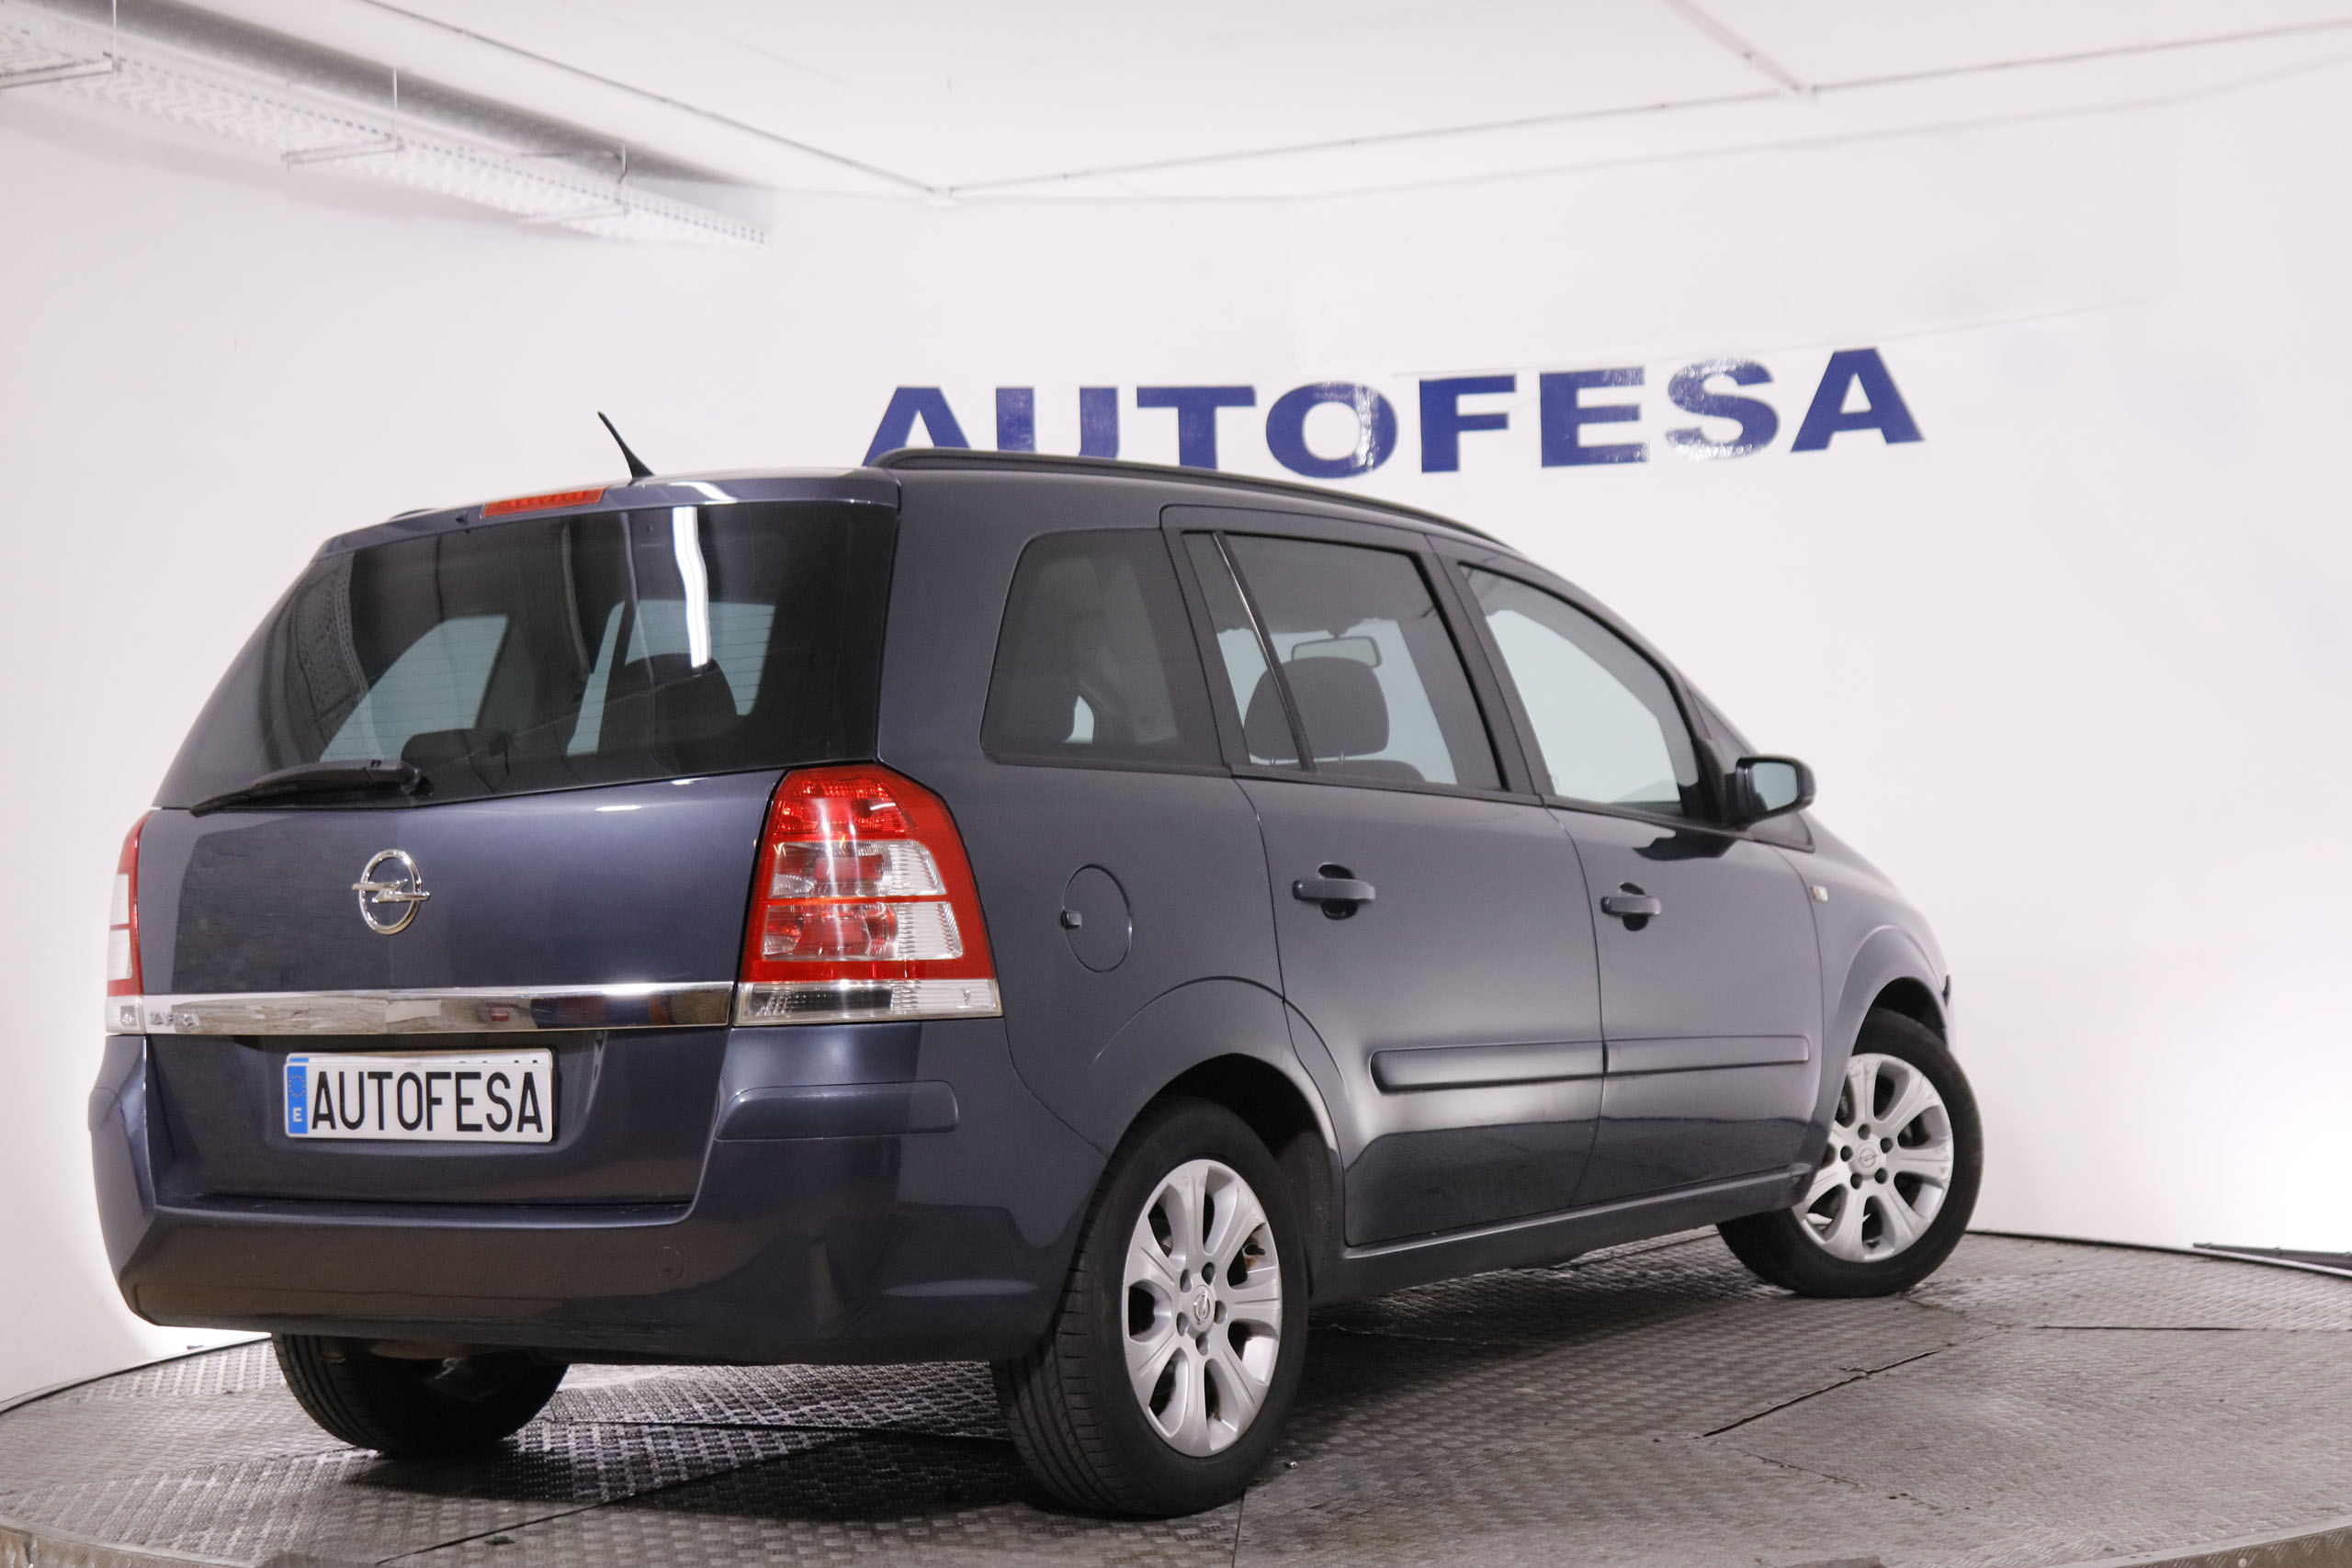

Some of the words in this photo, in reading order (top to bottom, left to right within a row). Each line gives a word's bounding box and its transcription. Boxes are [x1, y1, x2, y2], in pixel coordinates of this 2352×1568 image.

[861, 347, 1925, 479] AUTOFESA
[293, 1107, 302, 1122] E
[311, 1071, 544, 1133] AUTOFESA
